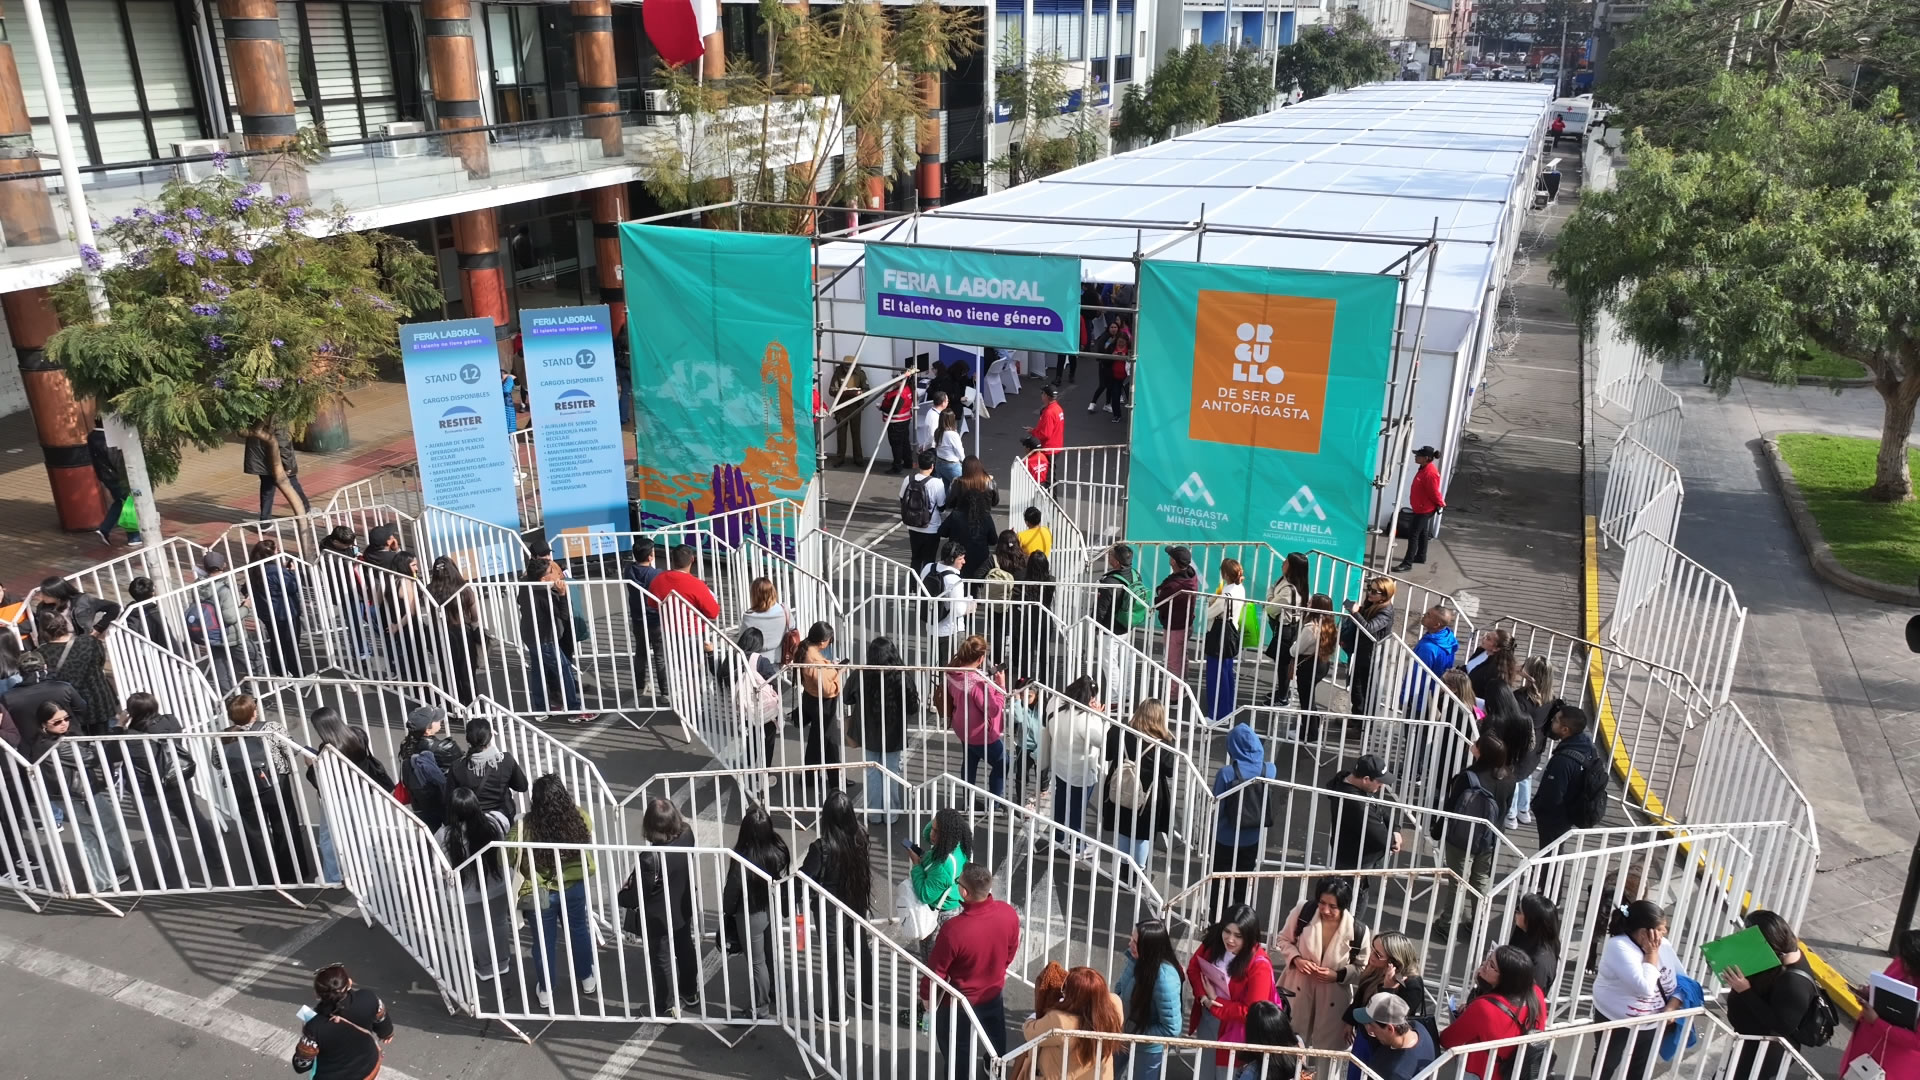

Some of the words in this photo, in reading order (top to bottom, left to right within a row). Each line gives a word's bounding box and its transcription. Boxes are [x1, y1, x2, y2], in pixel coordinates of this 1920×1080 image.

[884, 269, 940, 294] FERIA
[946, 275, 1044, 301] LABORAL
[883, 299, 894, 312] El
[899, 302, 942, 316] talento
[947, 308, 962, 318] no
[967, 307, 999, 321] tiene
[1004, 310, 1050, 325] género
[559, 315, 595, 324] LABORAL
[414, 332, 439, 341] FERIA
[440, 328, 479, 338] LABORAL
[543, 358, 573, 367] STAND
[579, 354, 594, 365] 12
[425, 373, 457, 384] STAND
[462, 368, 480, 380] 12
[423, 395, 449, 404] CARGOS
[450, 392, 490, 401] DISPONIBLES
[1218, 388, 1237, 398] DE
[1243, 390, 1269, 401] SER
[1276, 393, 1295, 404] DE
[555, 400, 595, 410] RESITER
[1202, 400, 1309, 420] ANTOFAGASTA
[439, 416, 482, 429] RESITER
[1157, 504, 1228, 522] ANTOFAGASTA
[1166, 515, 1217, 529] MINERALS
[1270, 521, 1332, 535] CENTINELA
[1263, 533, 1305, 542] ANTOFAGASTA
